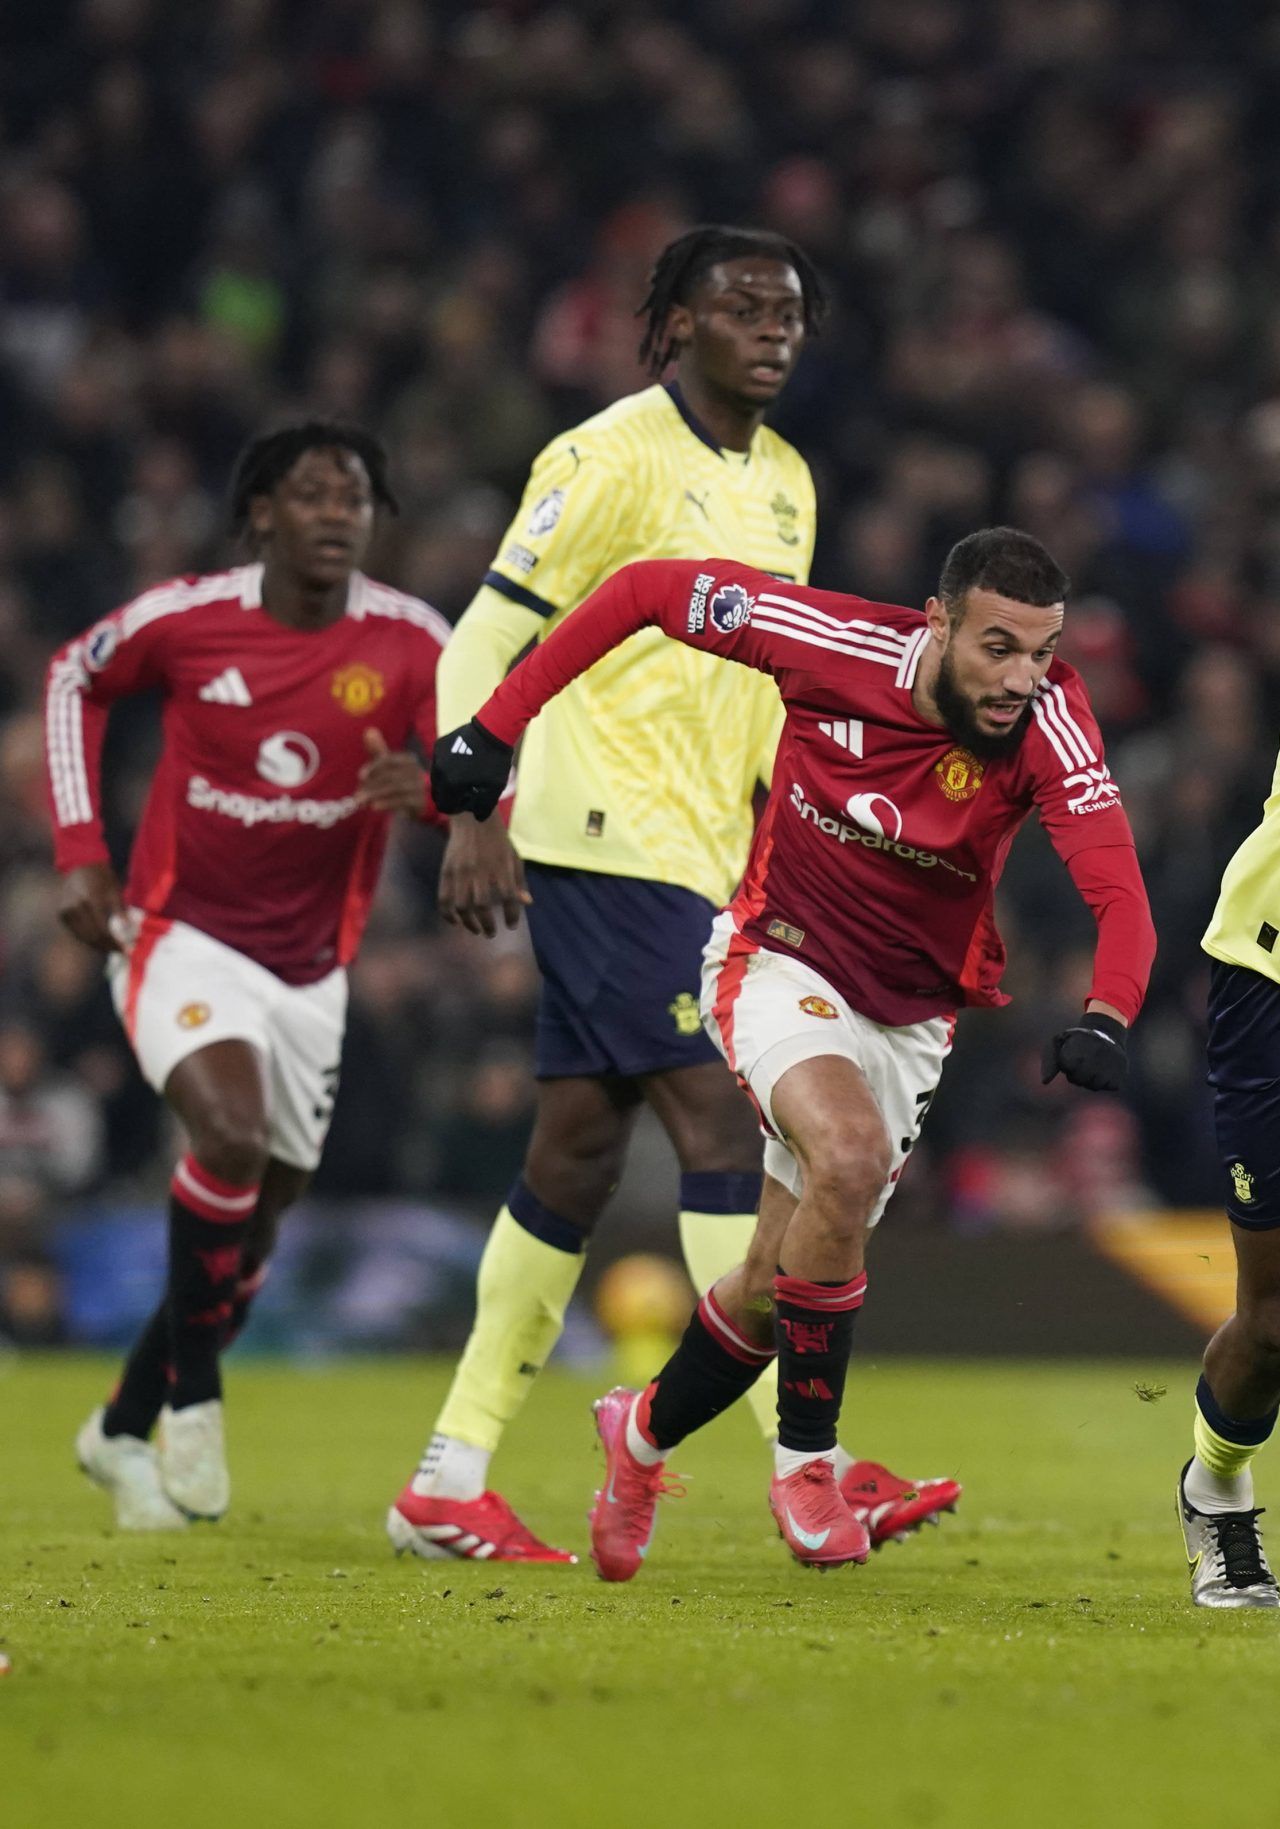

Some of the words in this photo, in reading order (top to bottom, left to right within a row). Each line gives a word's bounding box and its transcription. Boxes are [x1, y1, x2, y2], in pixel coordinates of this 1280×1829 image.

[699, 573, 716, 594] No
[697, 594, 707, 630] room
[941, 783, 969, 799] UNITED
[789, 783, 977, 882] Snapdragon
